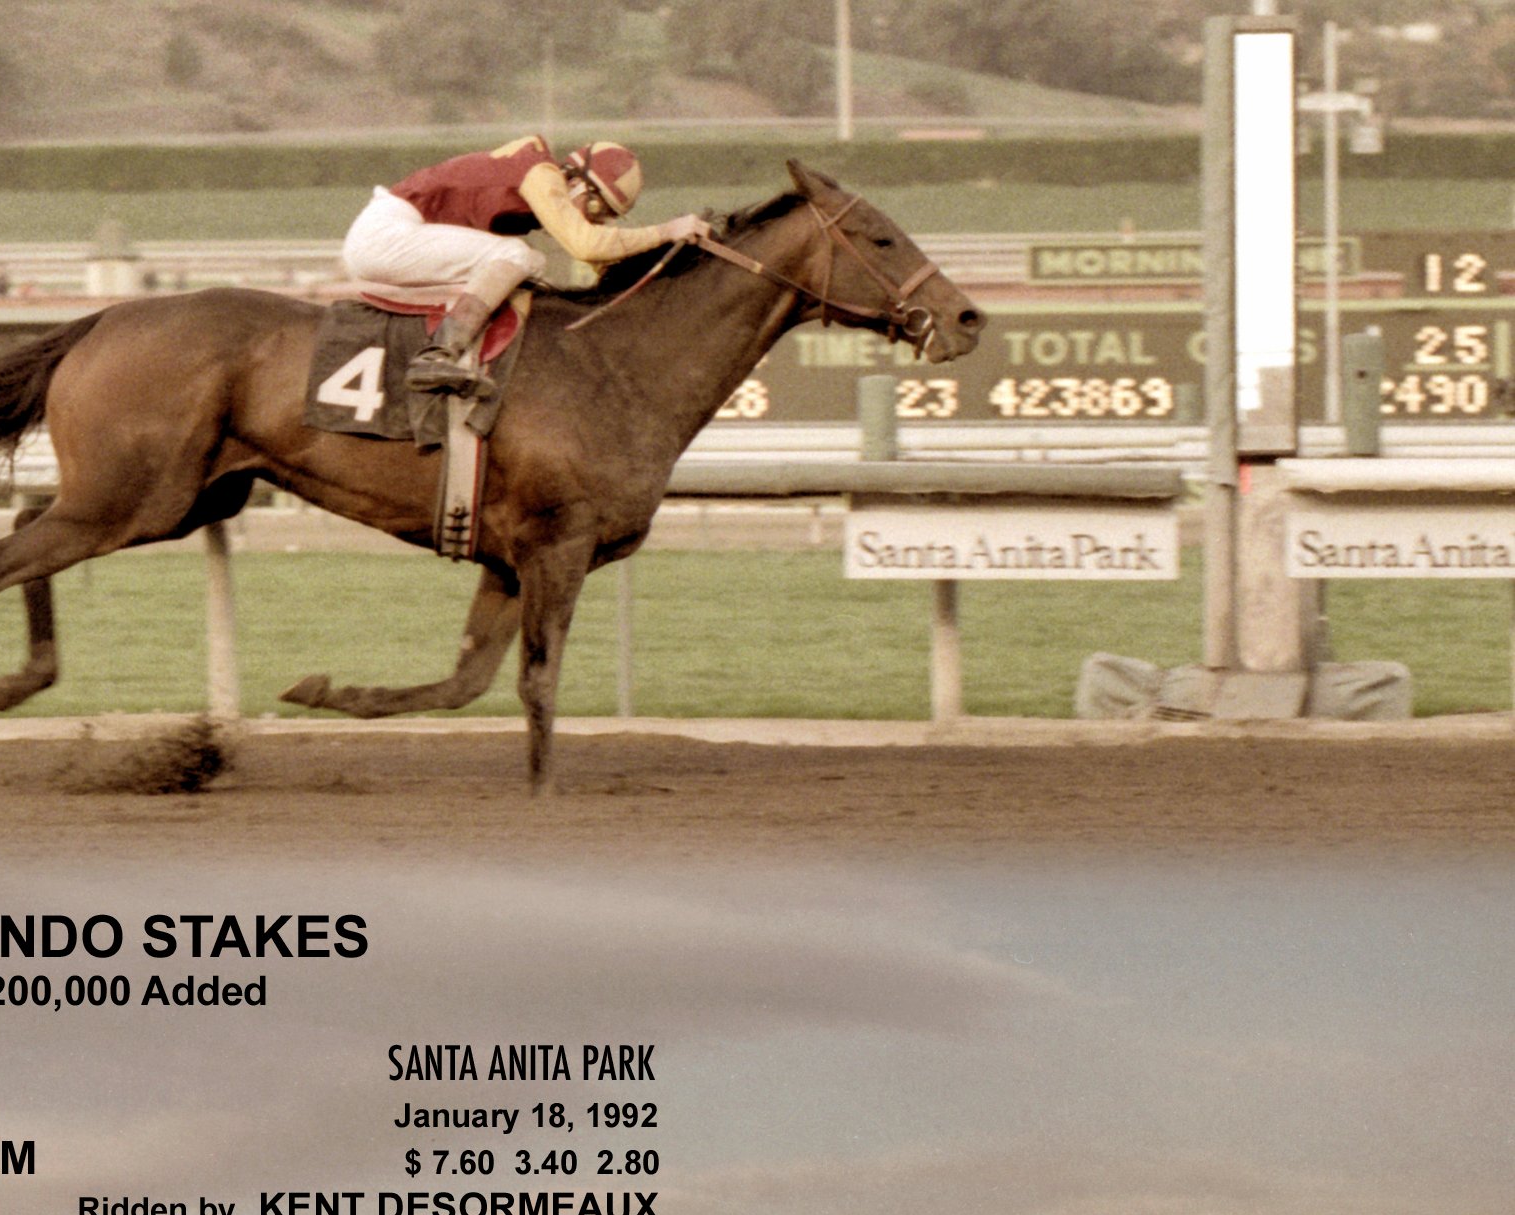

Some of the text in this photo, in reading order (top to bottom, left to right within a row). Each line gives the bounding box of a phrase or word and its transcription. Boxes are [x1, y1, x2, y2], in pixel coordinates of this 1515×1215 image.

[1425, 253, 1486, 292] 12
[1003, 331, 1158, 365] TOTAL
[1414, 325, 1488, 364] 25
[316, 346, 385, 422] 4
[988, 376, 1174, 417] 423869
[858, 530, 1162, 570] Santa Anita Park
[1299, 530, 1401, 568] Santa
